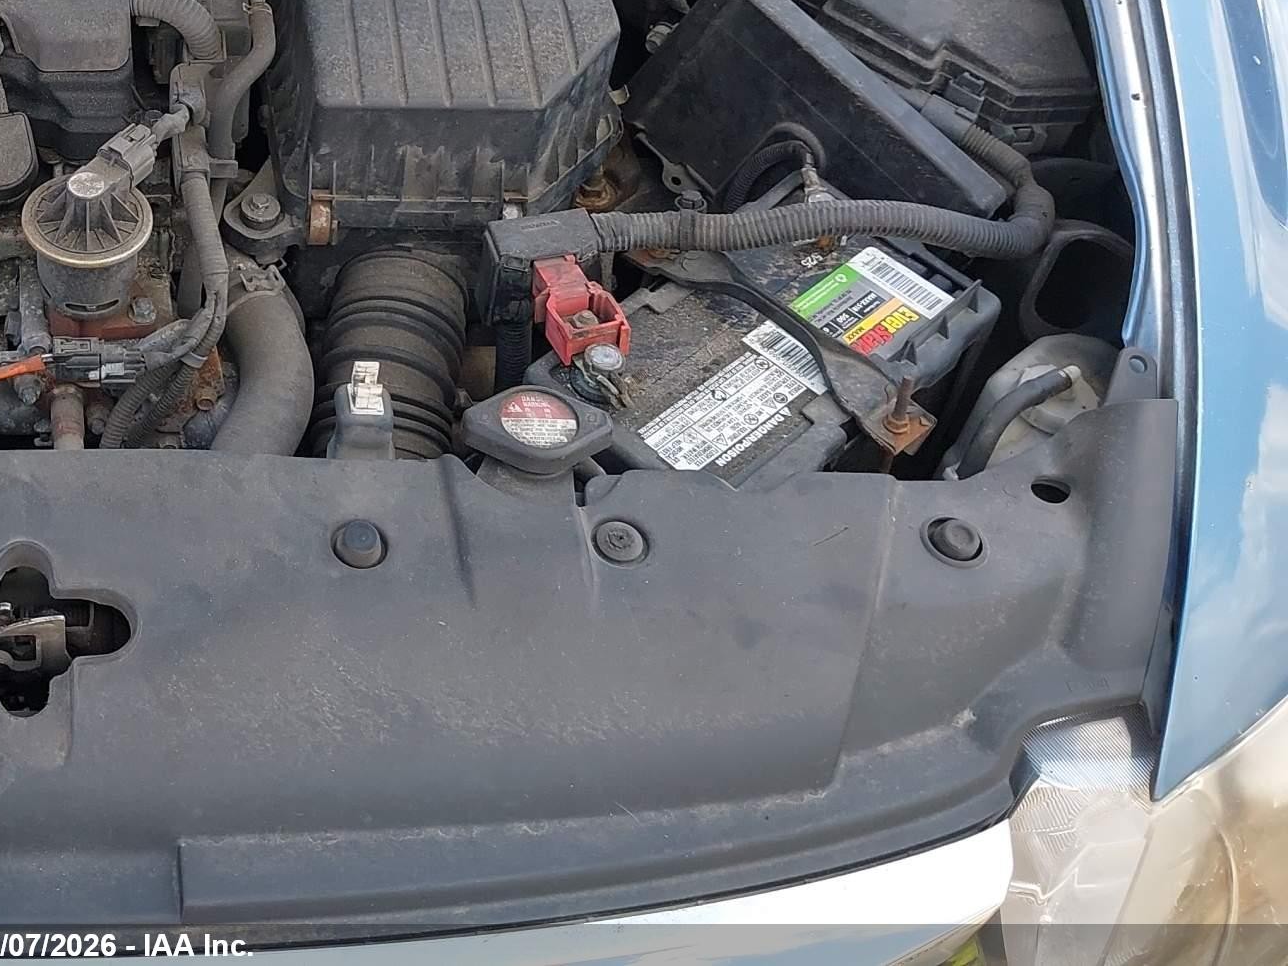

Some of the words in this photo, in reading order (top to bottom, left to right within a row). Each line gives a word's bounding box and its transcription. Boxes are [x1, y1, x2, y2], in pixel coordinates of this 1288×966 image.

[801, 252, 823, 268] 5/25
[847, 326, 865, 340] MAXX
[715, 414, 784, 467] DANGER/POISON
